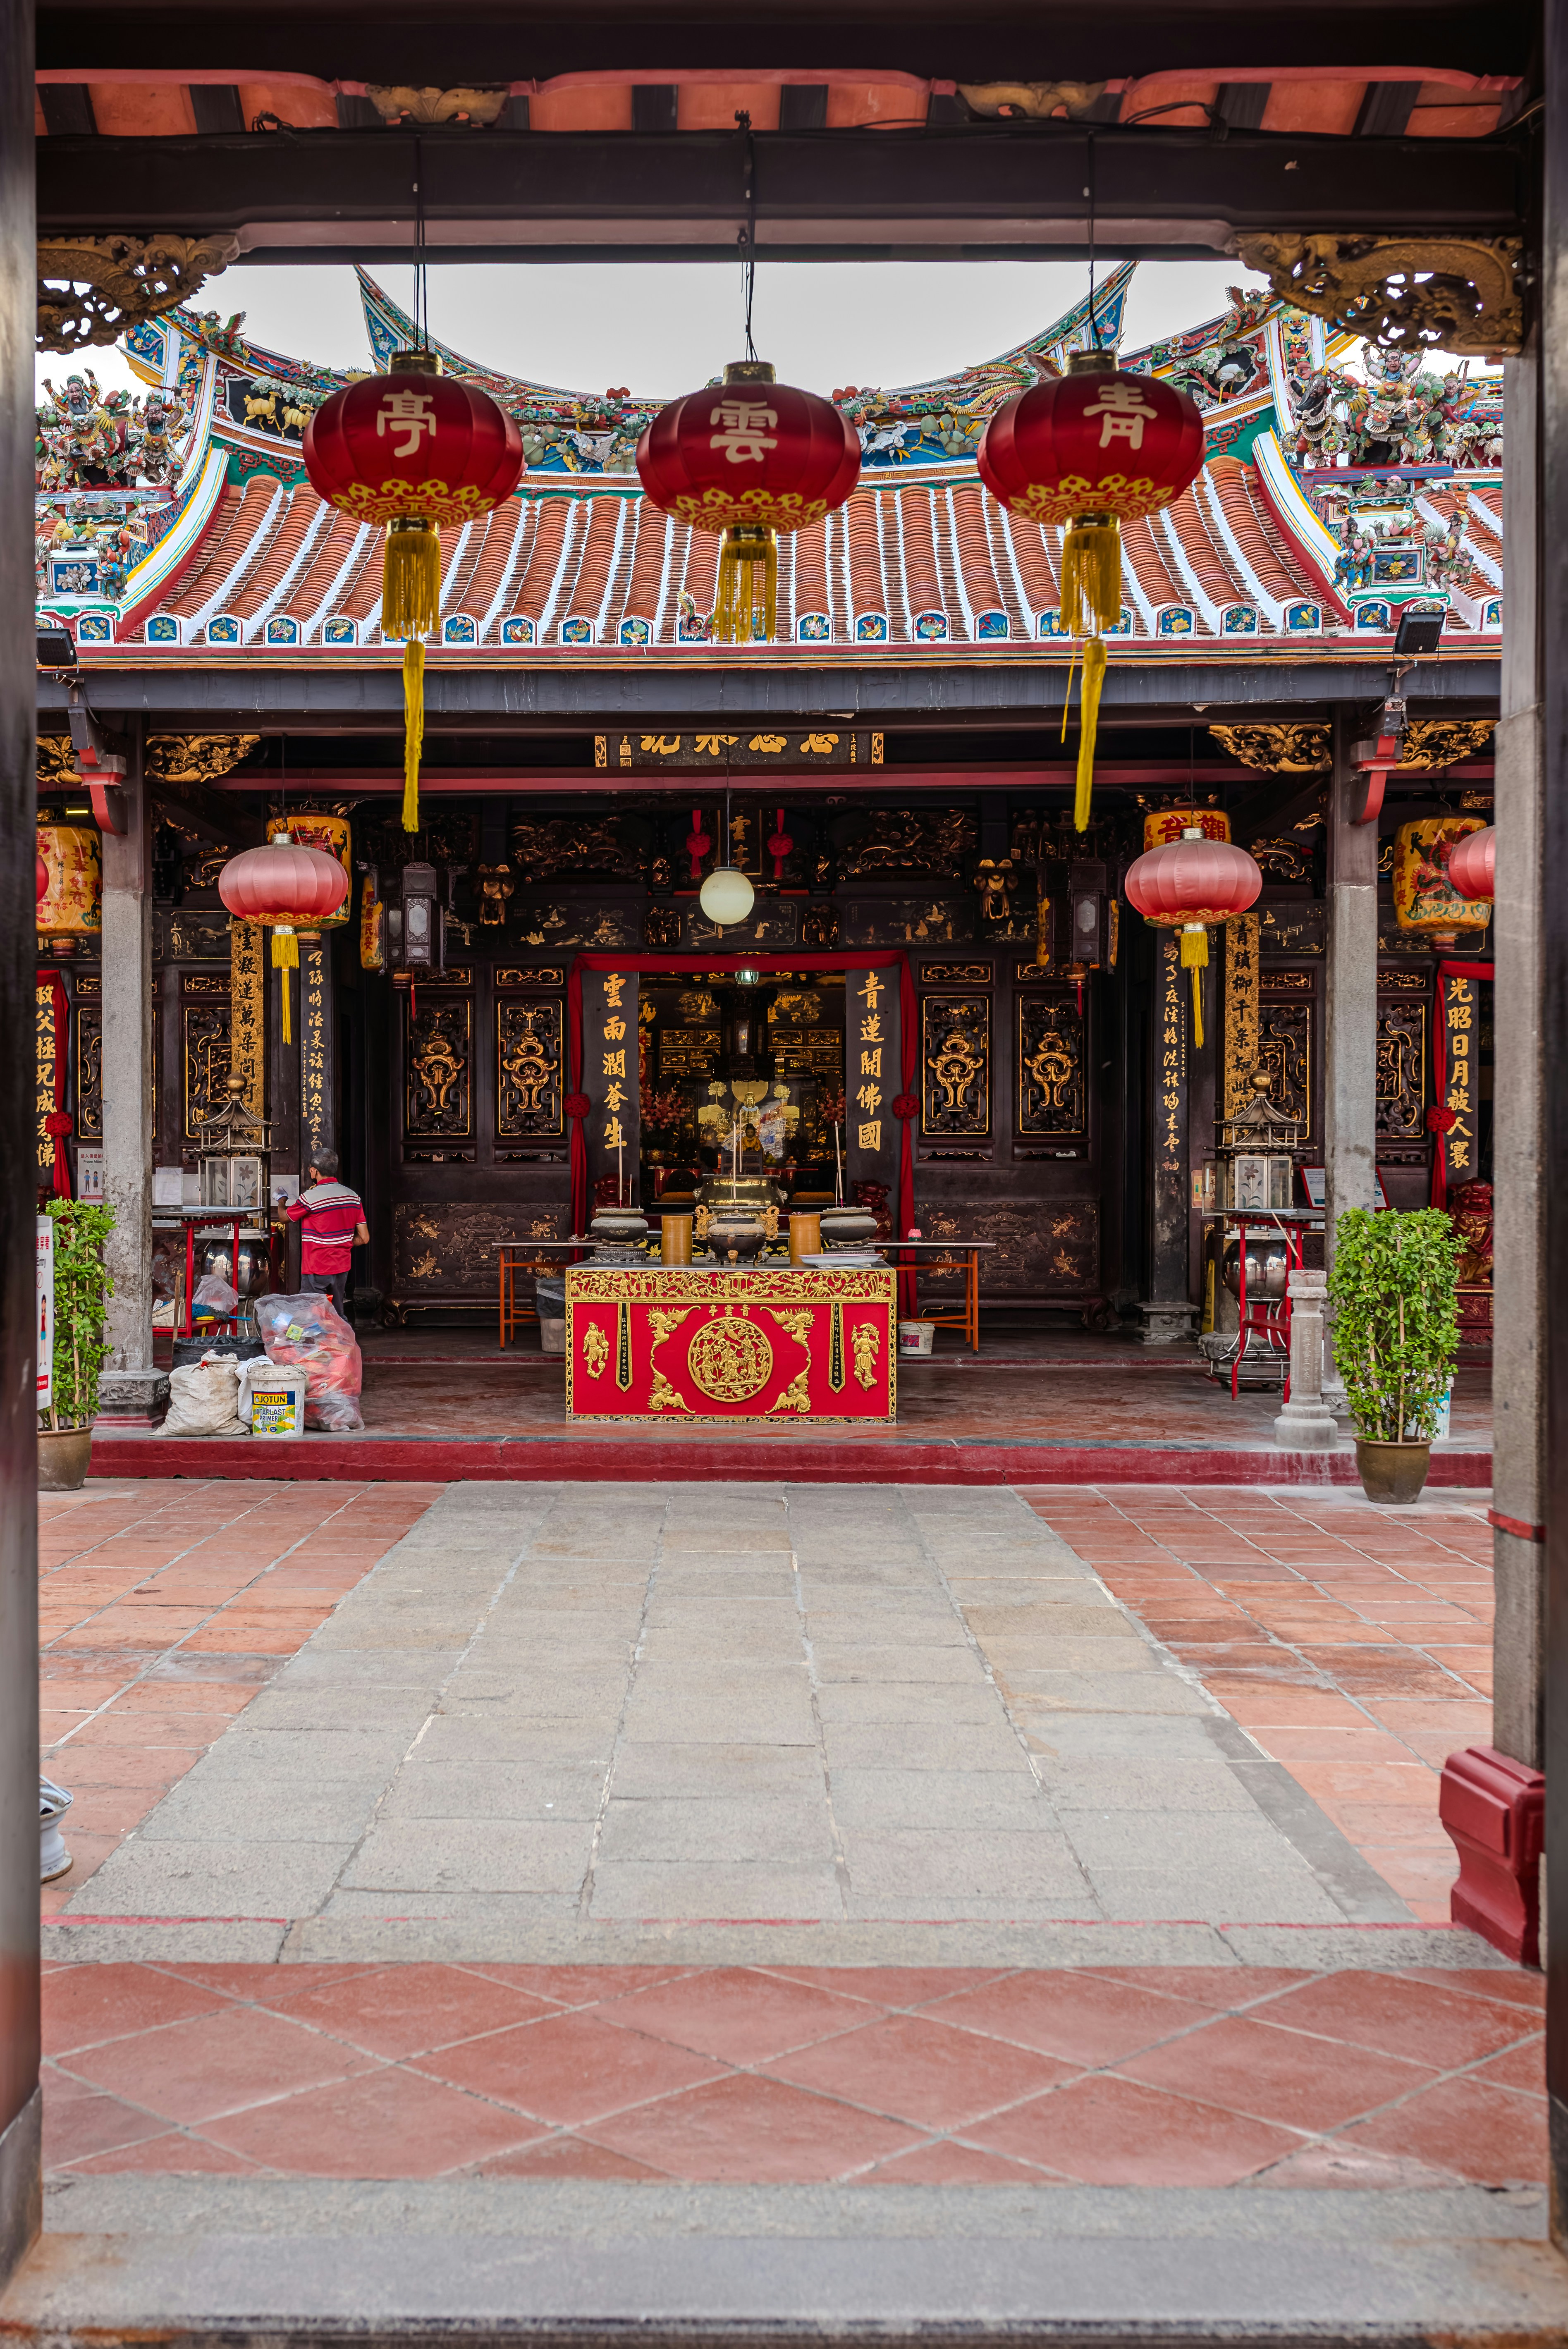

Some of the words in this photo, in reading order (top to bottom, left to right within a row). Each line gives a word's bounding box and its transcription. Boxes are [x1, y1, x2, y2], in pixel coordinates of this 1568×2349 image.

[376, 389, 437, 458] 亭
[710, 399, 778, 464] 雲
[1083, 382, 1158, 450] 青
[602, 973, 629, 1150] 雲雨潤蒼生
[856, 971, 885, 1152] 青蓮開佛國
